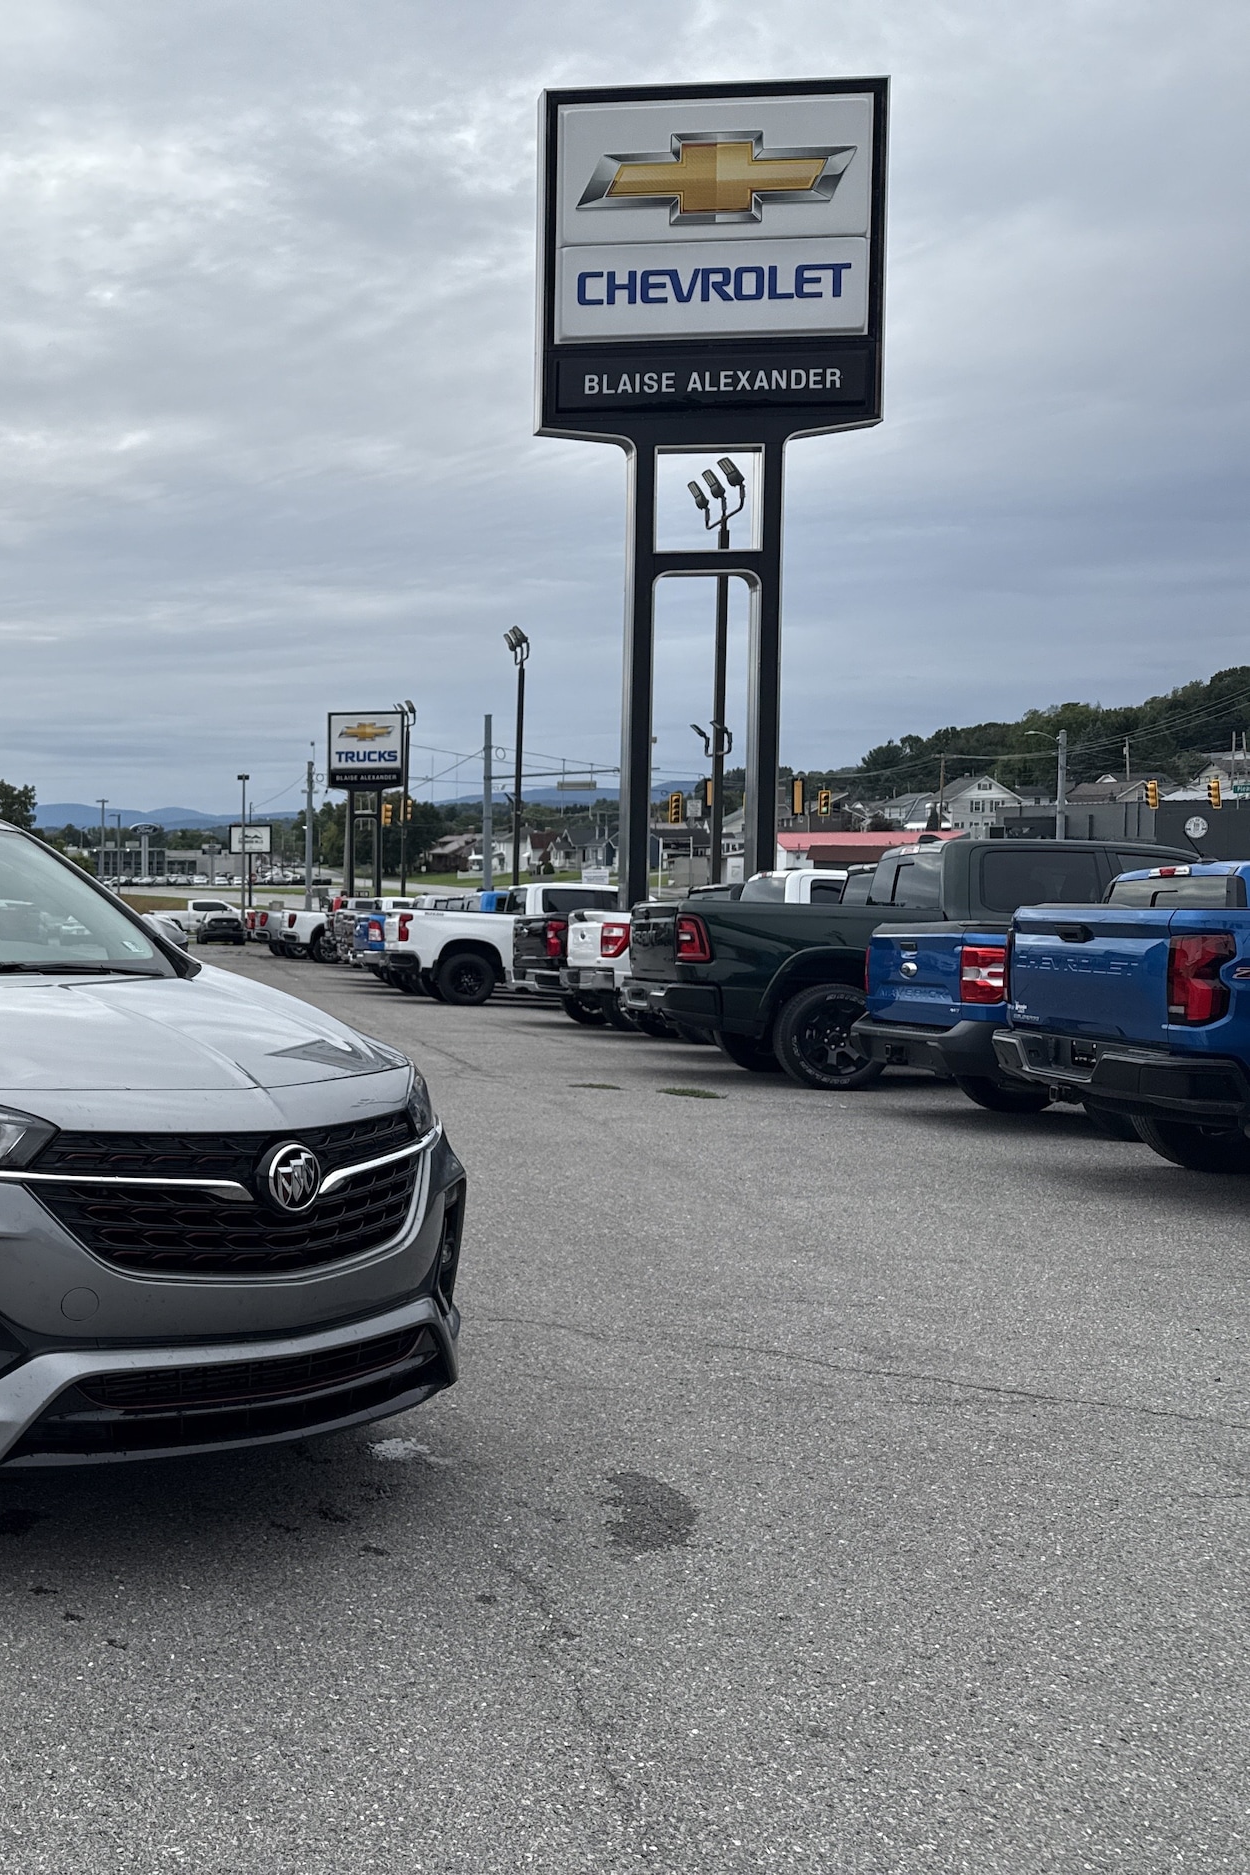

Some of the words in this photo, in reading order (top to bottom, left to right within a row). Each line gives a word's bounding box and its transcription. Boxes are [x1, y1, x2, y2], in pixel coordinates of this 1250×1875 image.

[577, 262, 852, 306] CHEVROLET
[584, 372, 676, 395] BLAISE
[686, 368, 842, 392] ALEXANDER
[335, 750, 398, 763] TRUCKS
[136, 825, 154, 834] Ford
